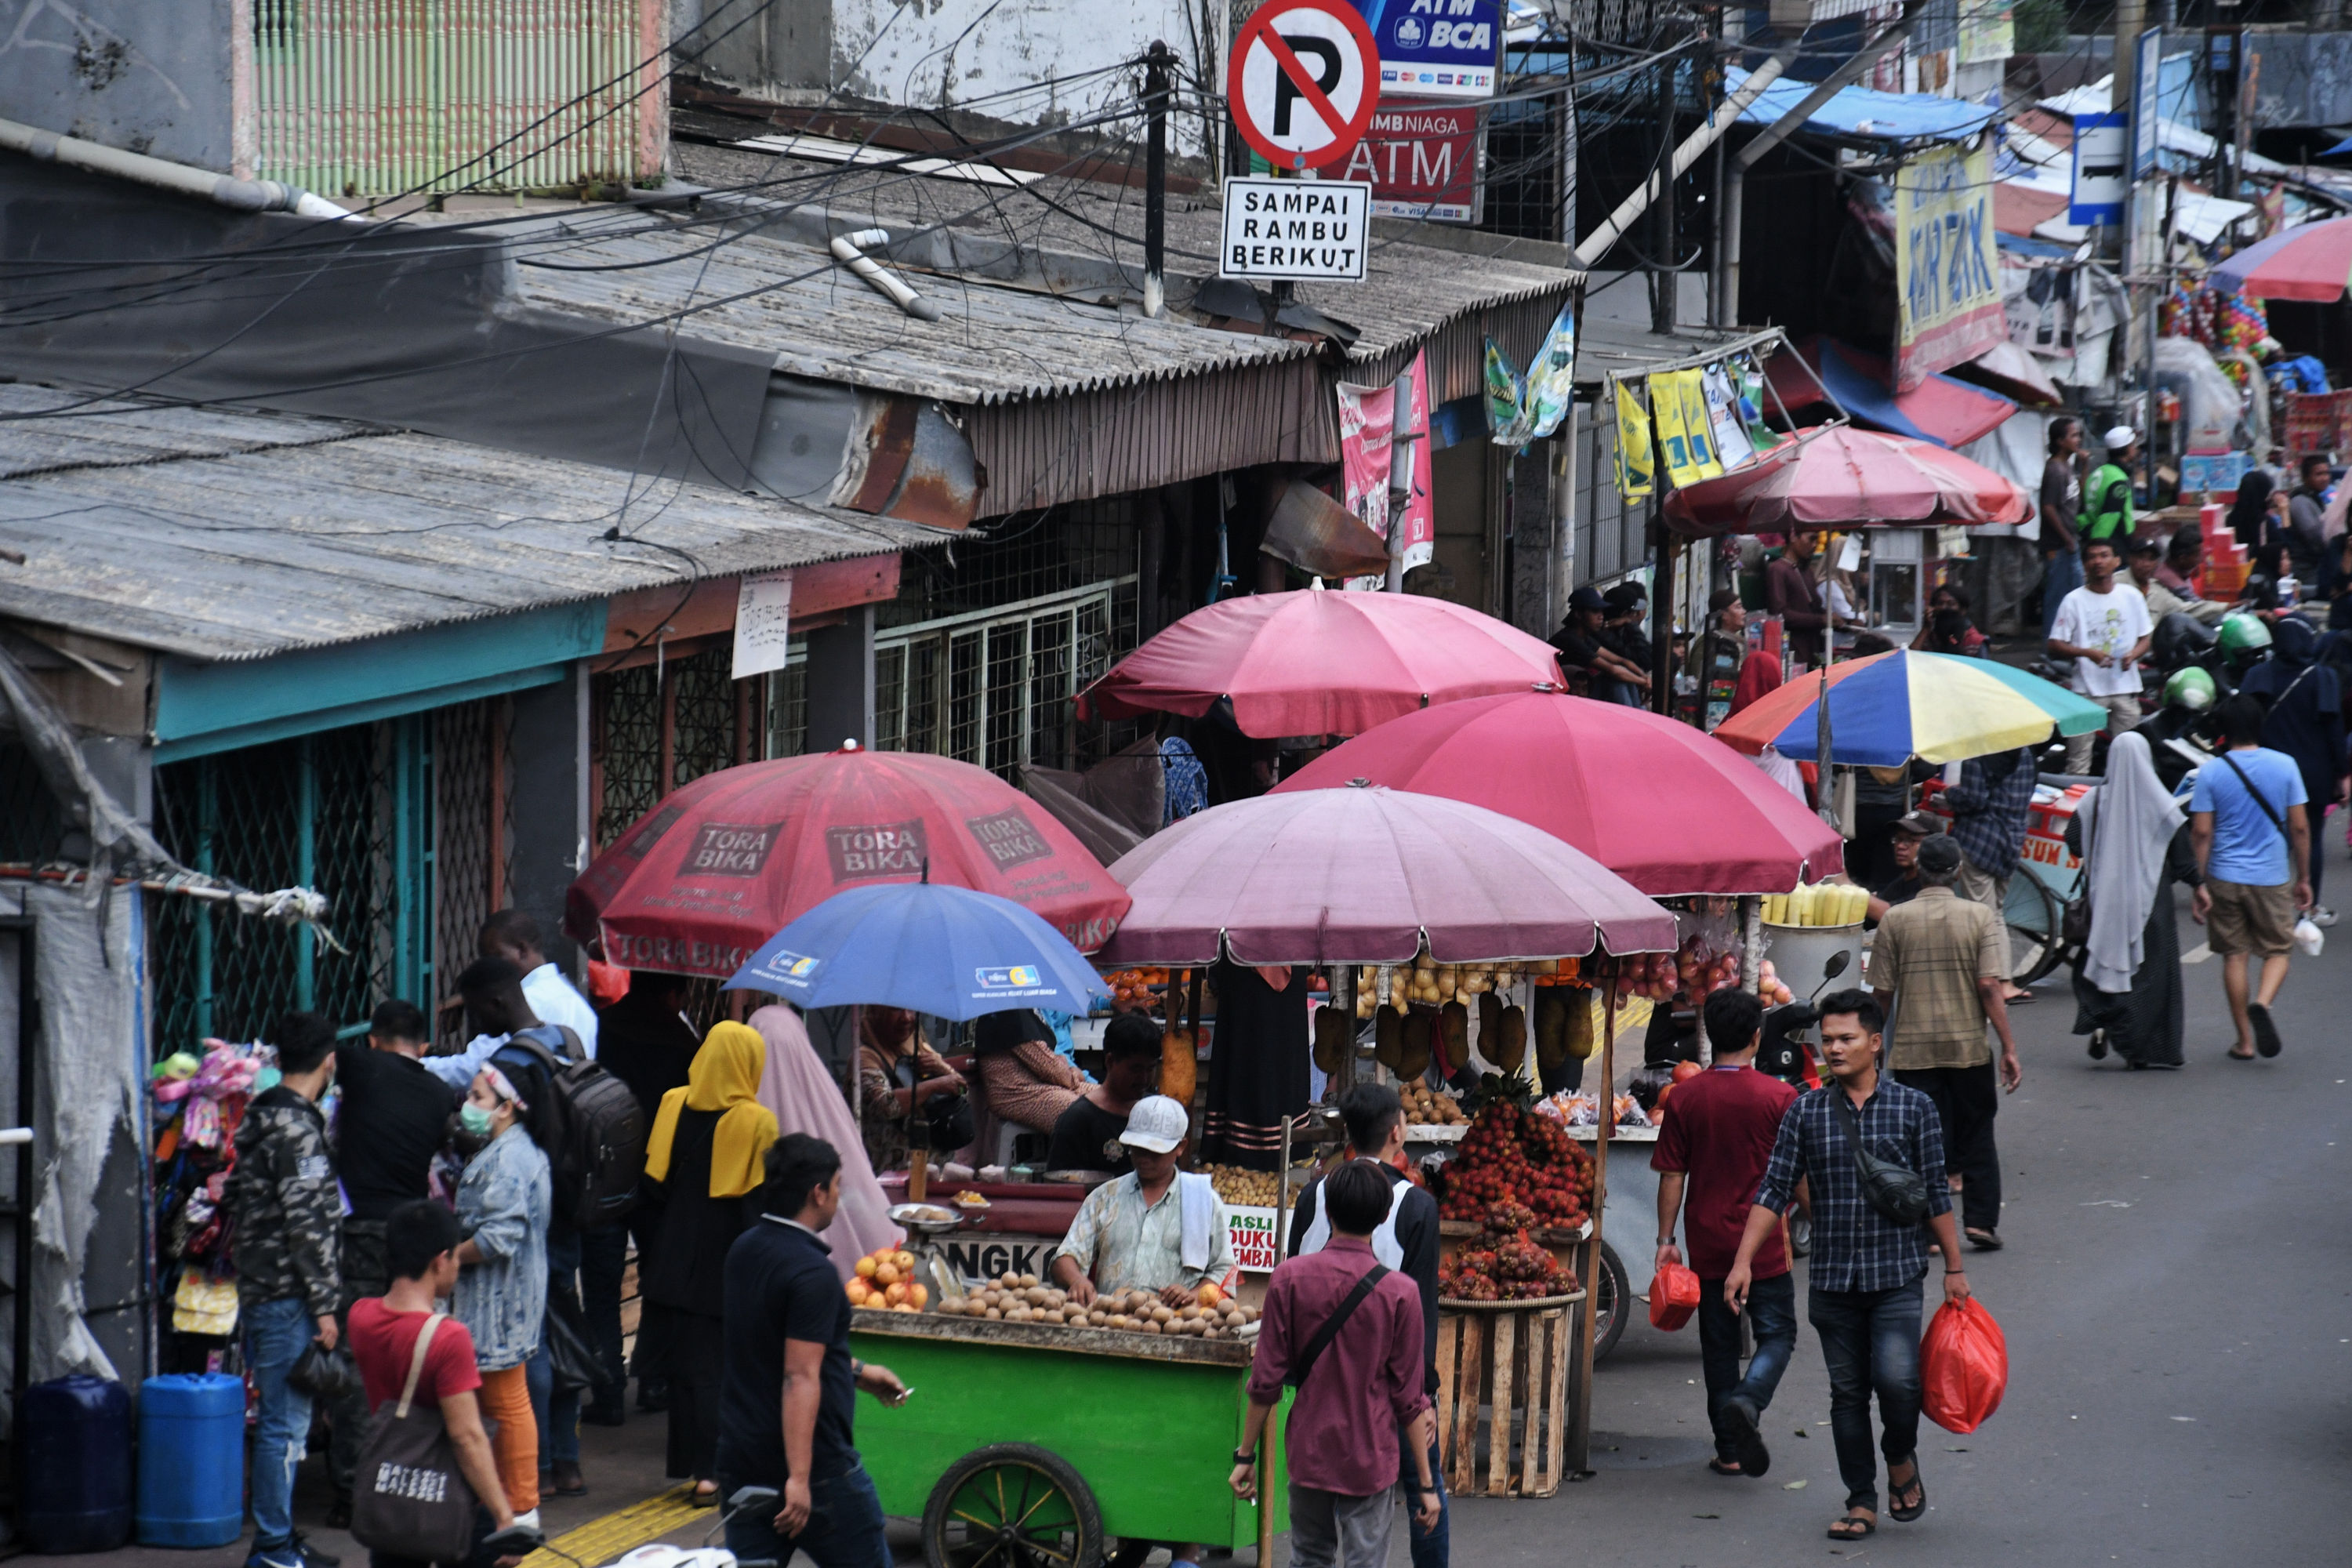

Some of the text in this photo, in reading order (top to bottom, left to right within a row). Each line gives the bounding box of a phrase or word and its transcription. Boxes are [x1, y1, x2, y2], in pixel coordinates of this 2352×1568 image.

[1428, 20, 1490, 50] BCA
[1370, 114, 1459, 134] IMB NIAGA
[1343, 137, 1452, 187] ATM
[1244, 191, 1348, 215] SAMPAI
[1243, 218, 1348, 241] RAMBU
[1232, 244, 1356, 268] BERIKUT
[703, 829, 768, 851] TORA
[833, 829, 918, 851] TORA
[973, 816, 1030, 843] TORA
[989, 834, 1045, 861] BIKA
[694, 849, 758, 870] BIKA
[844, 849, 921, 871] BIKA
[1229, 1214, 1272, 1231] ASLI
